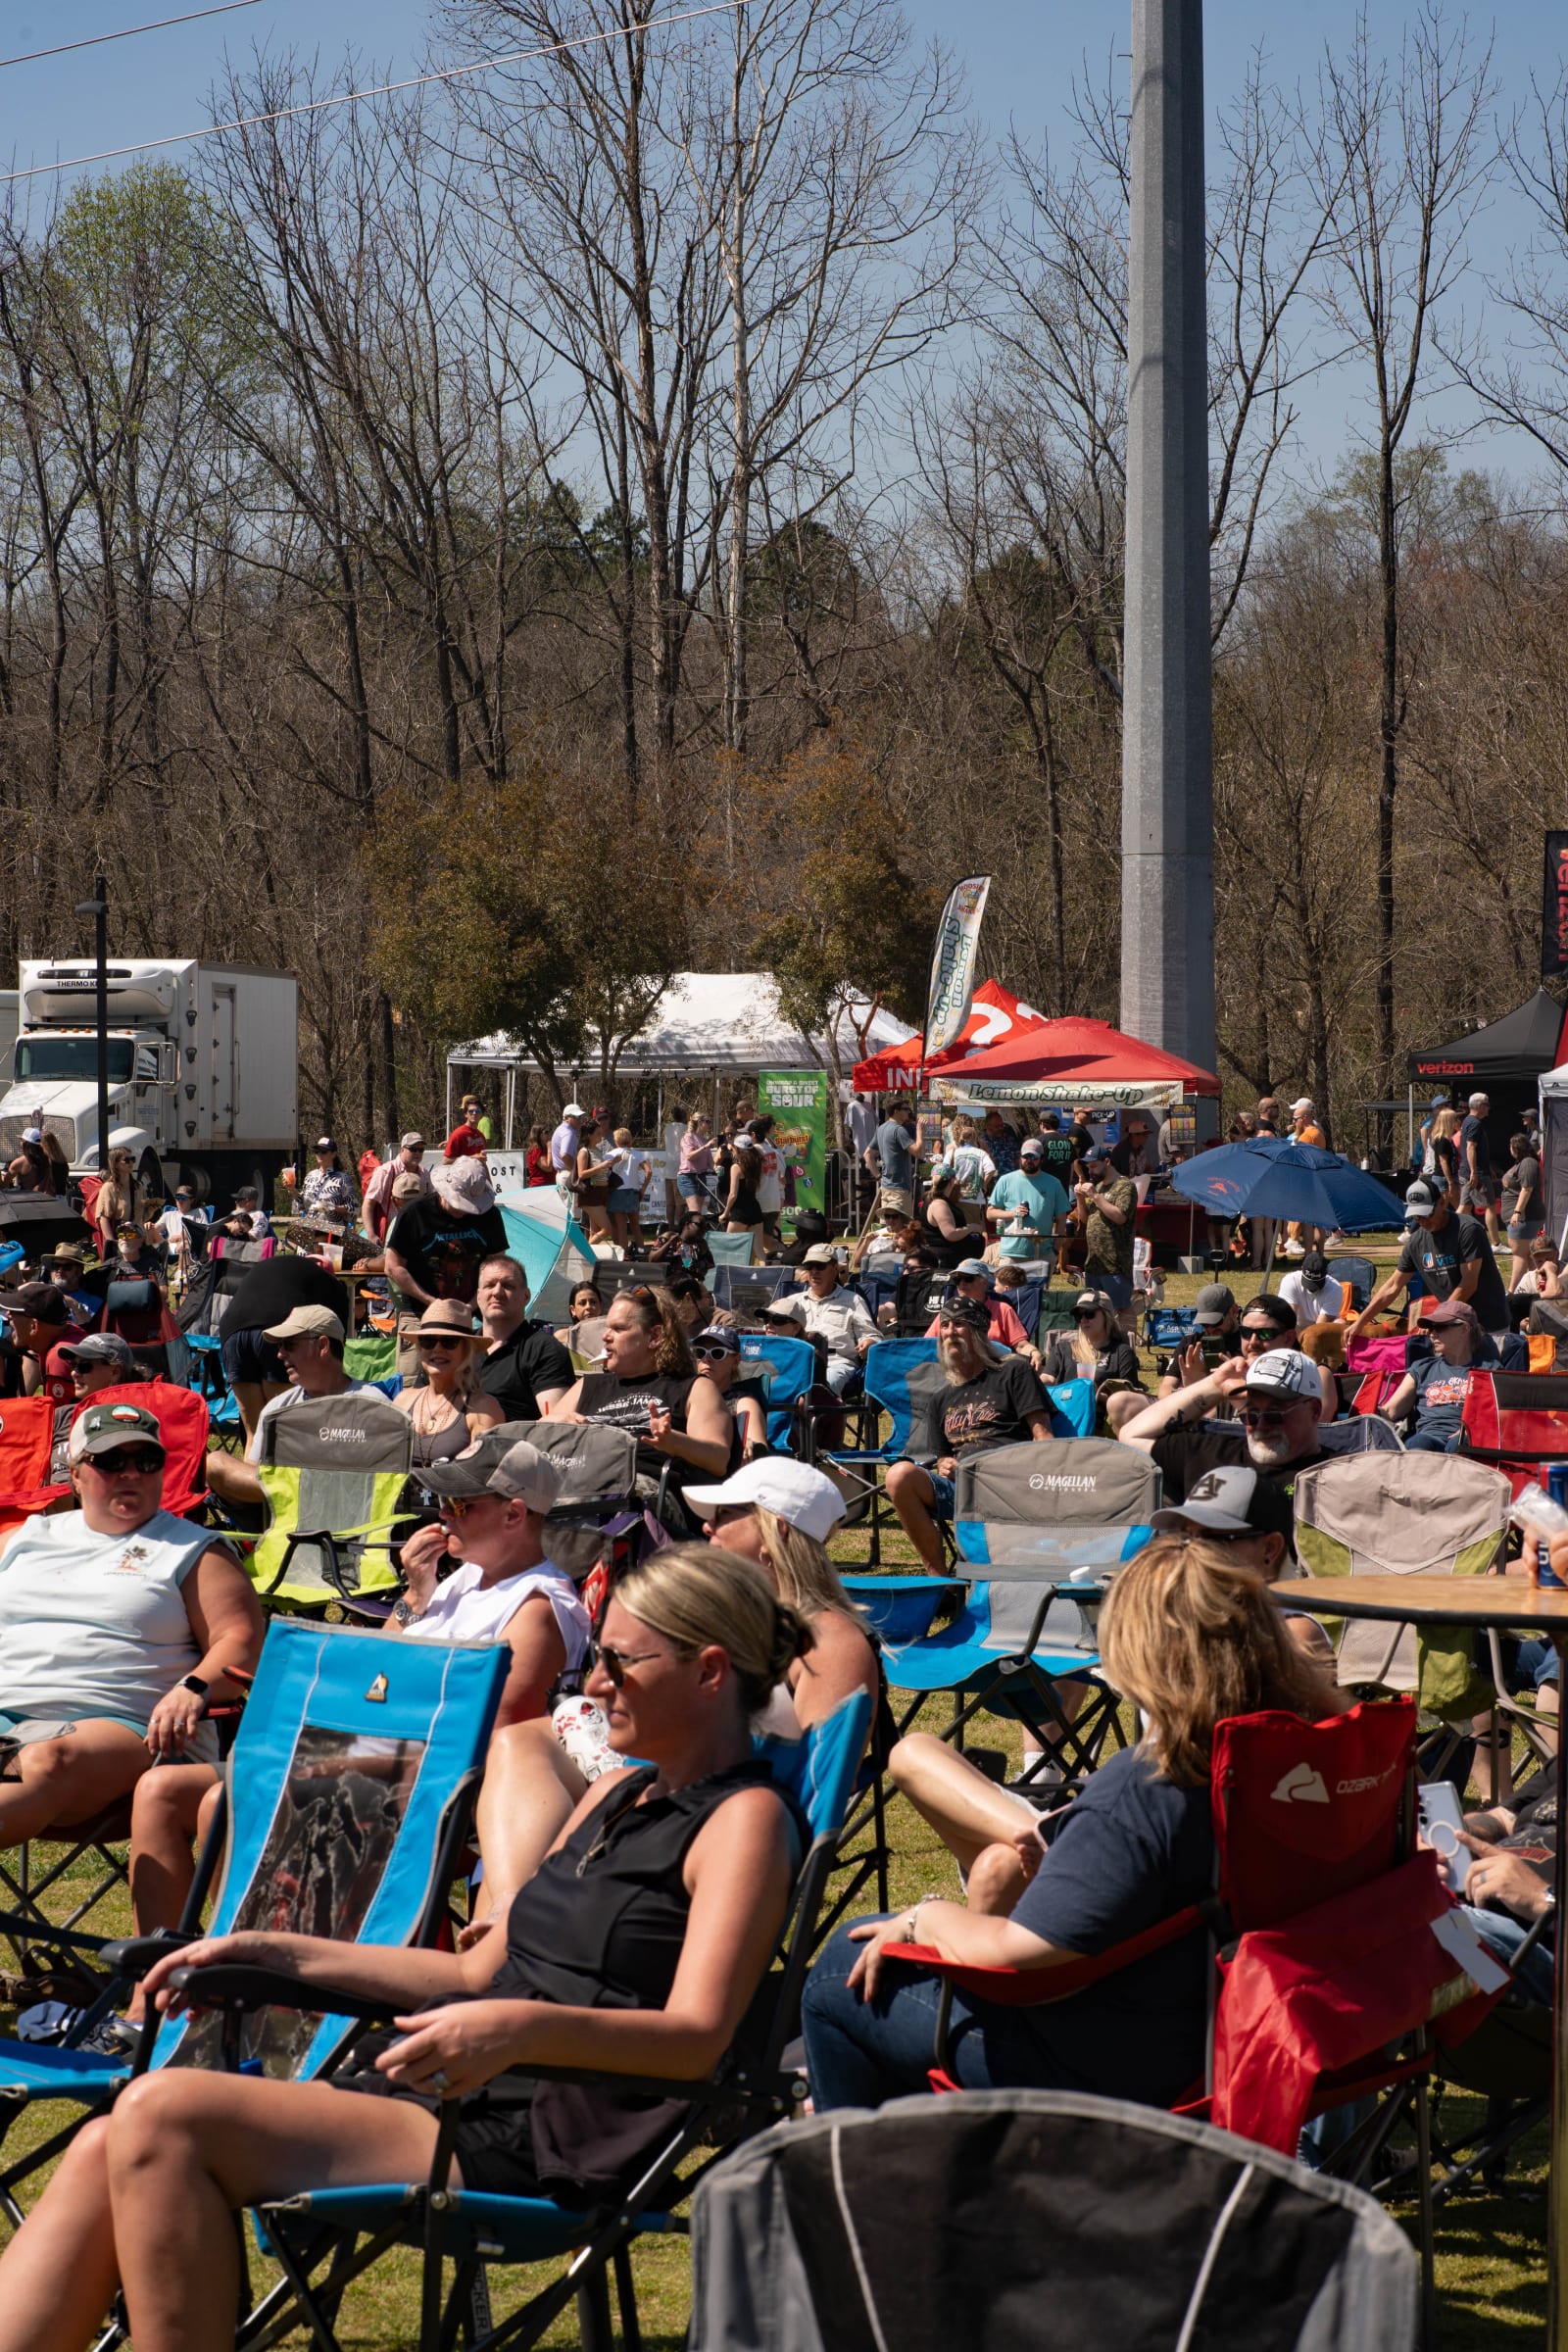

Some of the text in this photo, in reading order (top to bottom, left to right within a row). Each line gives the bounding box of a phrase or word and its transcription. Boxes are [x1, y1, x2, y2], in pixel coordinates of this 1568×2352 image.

[933, 915, 960, 1025] Shake-Up
[952, 934, 972, 1007] Lemon
[1416, 1059, 1474, 1074] verizon
[765, 1085, 819, 1094] BURST OF
[968, 1084, 1039, 1101] Lemon
[1040, 1085, 1144, 1105] Shake-Up
[771, 1094, 814, 1107] SOUR
[1048, 1140, 1071, 1150] GLOW
[1048, 1151, 1072, 1160] FOR IT
[495, 1184, 503, 1194] &
[630, 1396, 663, 1408] JAMS
[1047, 1474, 1097, 1487] MAGELLAN
[1336, 1776, 1380, 1794] OZARK
